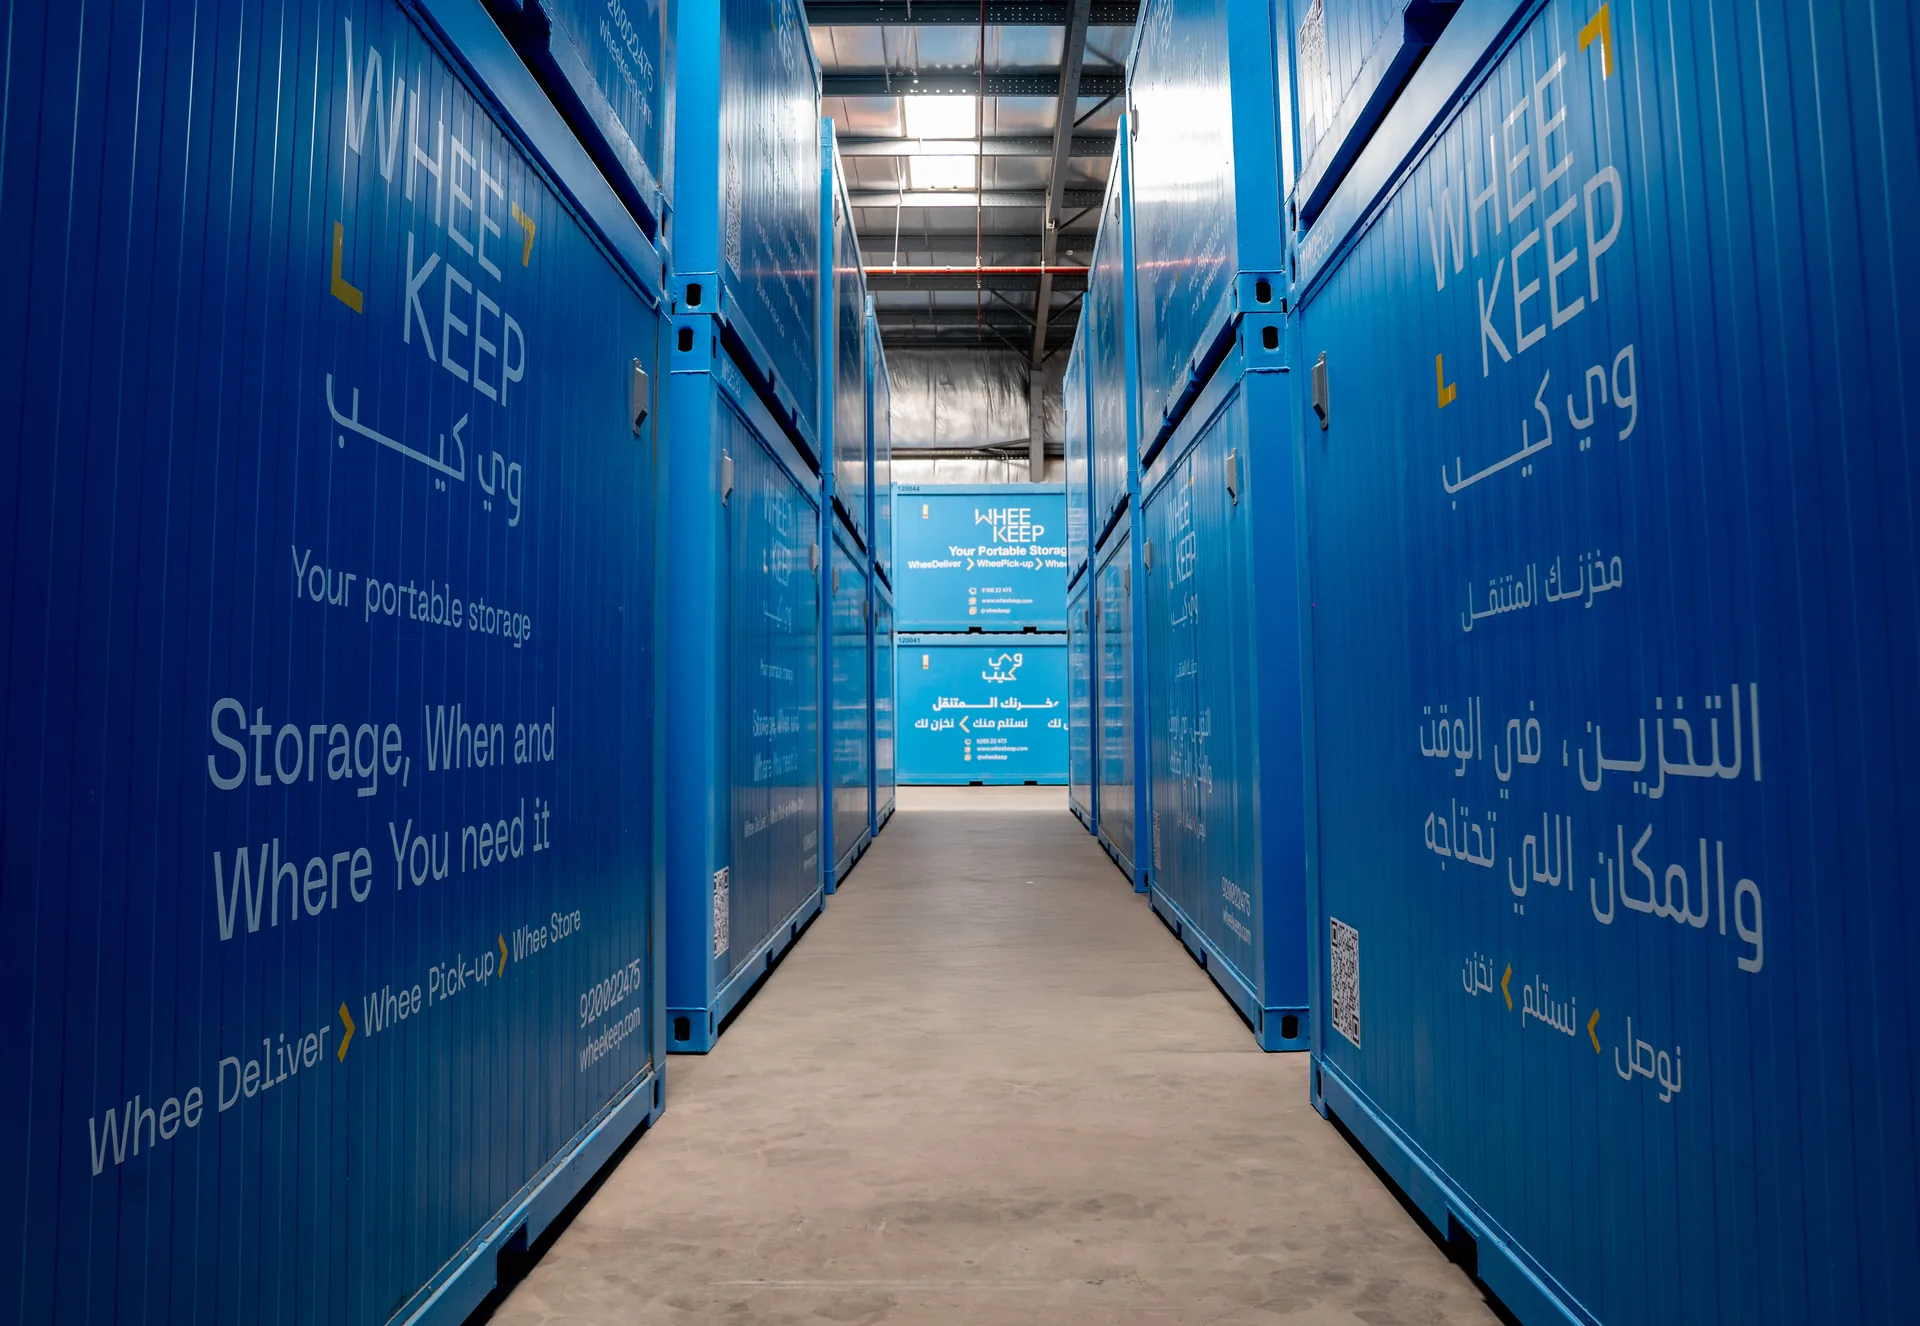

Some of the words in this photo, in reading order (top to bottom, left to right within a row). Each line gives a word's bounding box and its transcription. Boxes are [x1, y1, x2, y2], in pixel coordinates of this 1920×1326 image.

[604, 0, 653, 92] 20022475
[344, 16, 504, 282] WHEE
[1428, 51, 1575, 291] WHEE
[1477, 164, 1625, 378] KEEP
[403, 230, 526, 408] KEEP
[326, 372, 469, 493] كيب
[1442, 368, 1553, 510] كيب
[1567, 344, 1639, 452] وي
[477, 453, 523, 527] وي
[975, 508, 1031, 526] WHEE
[993, 525, 1045, 543] KEEP
[291, 544, 356, 608] Your
[365, 576, 464, 629] portable
[468, 596, 532, 649] storage
[908, 560, 962, 570] WheeDeliver
[977, 559, 1034, 569] WheePick-up
[949, 546, 976, 557] Your
[978, 546, 1027, 557] Portable
[1029, 545, 1067, 558] Storag
[1176, 531, 1197, 585] KEEP
[207, 697, 411, 798] Storage,
[425, 702, 504, 772] When
[514, 706, 556, 764] and
[1418, 696, 1483, 778] الوقت
[1494, 701, 1542, 799] في
[213, 838, 373, 942] Where
[389, 818, 449, 891] You
[461, 798, 526, 873] need
[533, 797, 550, 853] it
[1424, 798, 1495, 871] تحتاجه
[1508, 811, 1573, 916] اللي
[1590, 822, 1764, 974] والمكان
[580, 958, 641, 1029] 920022475
[1461, 951, 1494, 997] نخزن
[1522, 974, 1577, 1038] نستلم
[88, 1084, 203, 1177] Whee
[218, 1024, 330, 1113] Deliver
[363, 978, 422, 1038] Whee
[428, 947, 495, 1007] Pick-up
[512, 923, 548, 963] Whee
[550, 906, 582, 949] Store
[580, 1006, 641, 1073] wheekeep.com
[1614, 1015, 1683, 1104] نوصل
